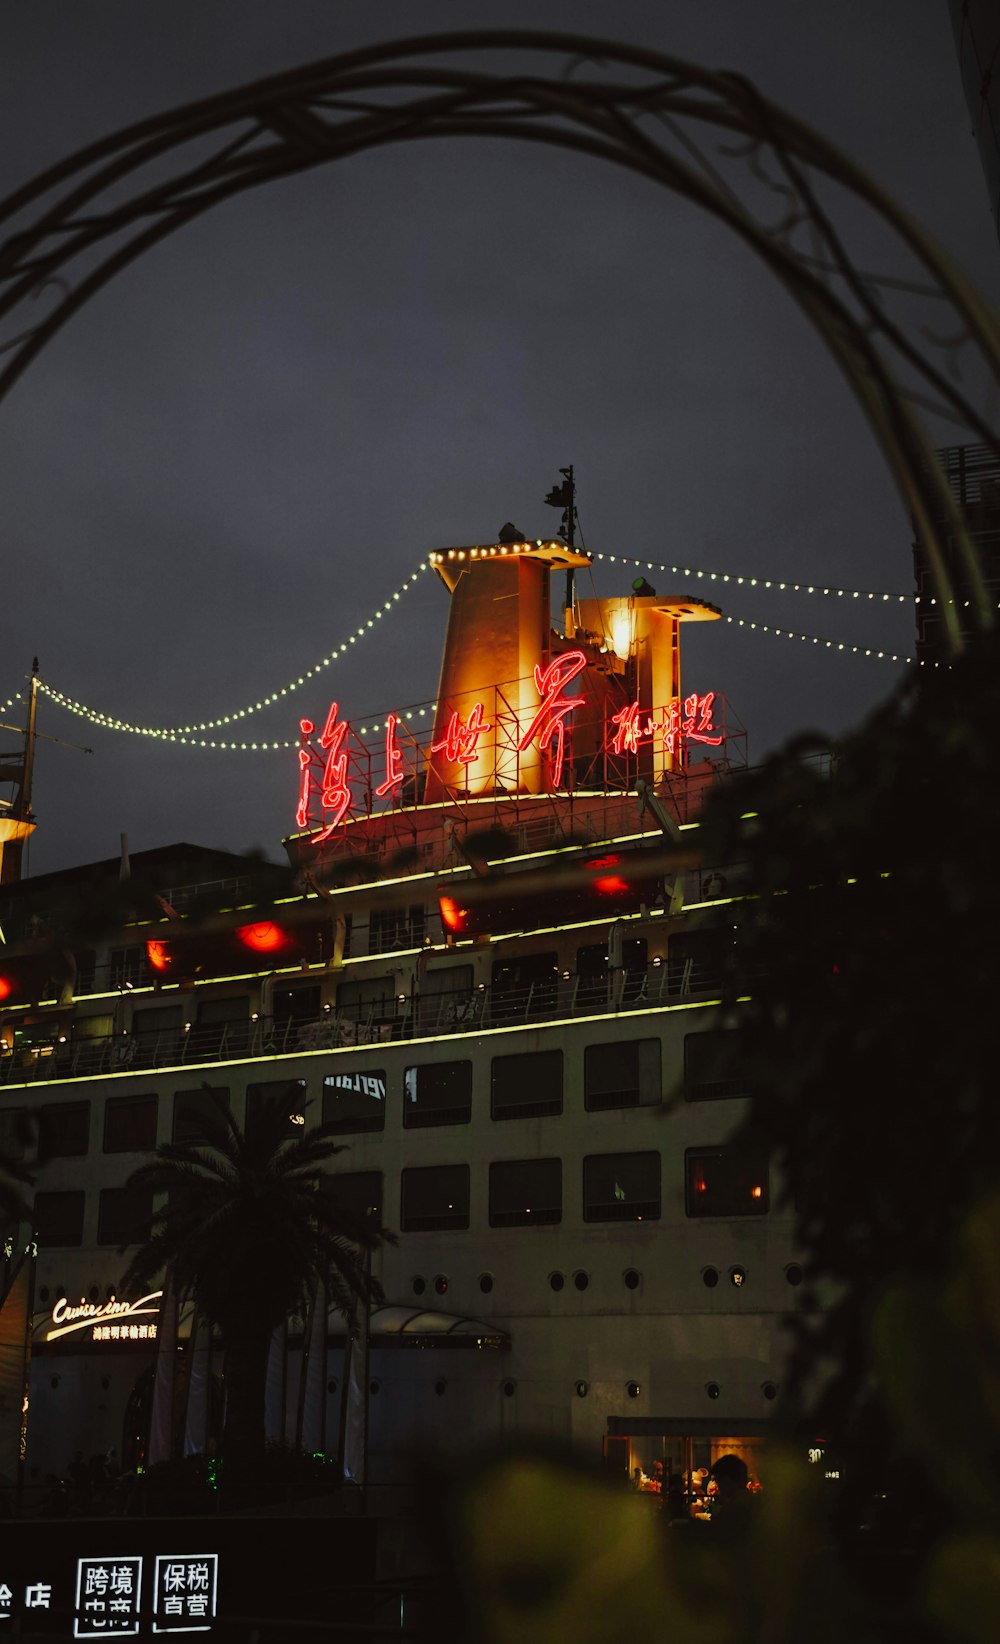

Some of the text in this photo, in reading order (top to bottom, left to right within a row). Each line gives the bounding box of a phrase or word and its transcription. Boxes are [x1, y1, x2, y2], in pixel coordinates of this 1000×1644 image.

[296, 650, 587, 844] 海上世界
[52, 1297, 100, 1324] Cruise
[85, 1565, 133, 1596] 跨境
[164, 1563, 209, 1592] 保税
